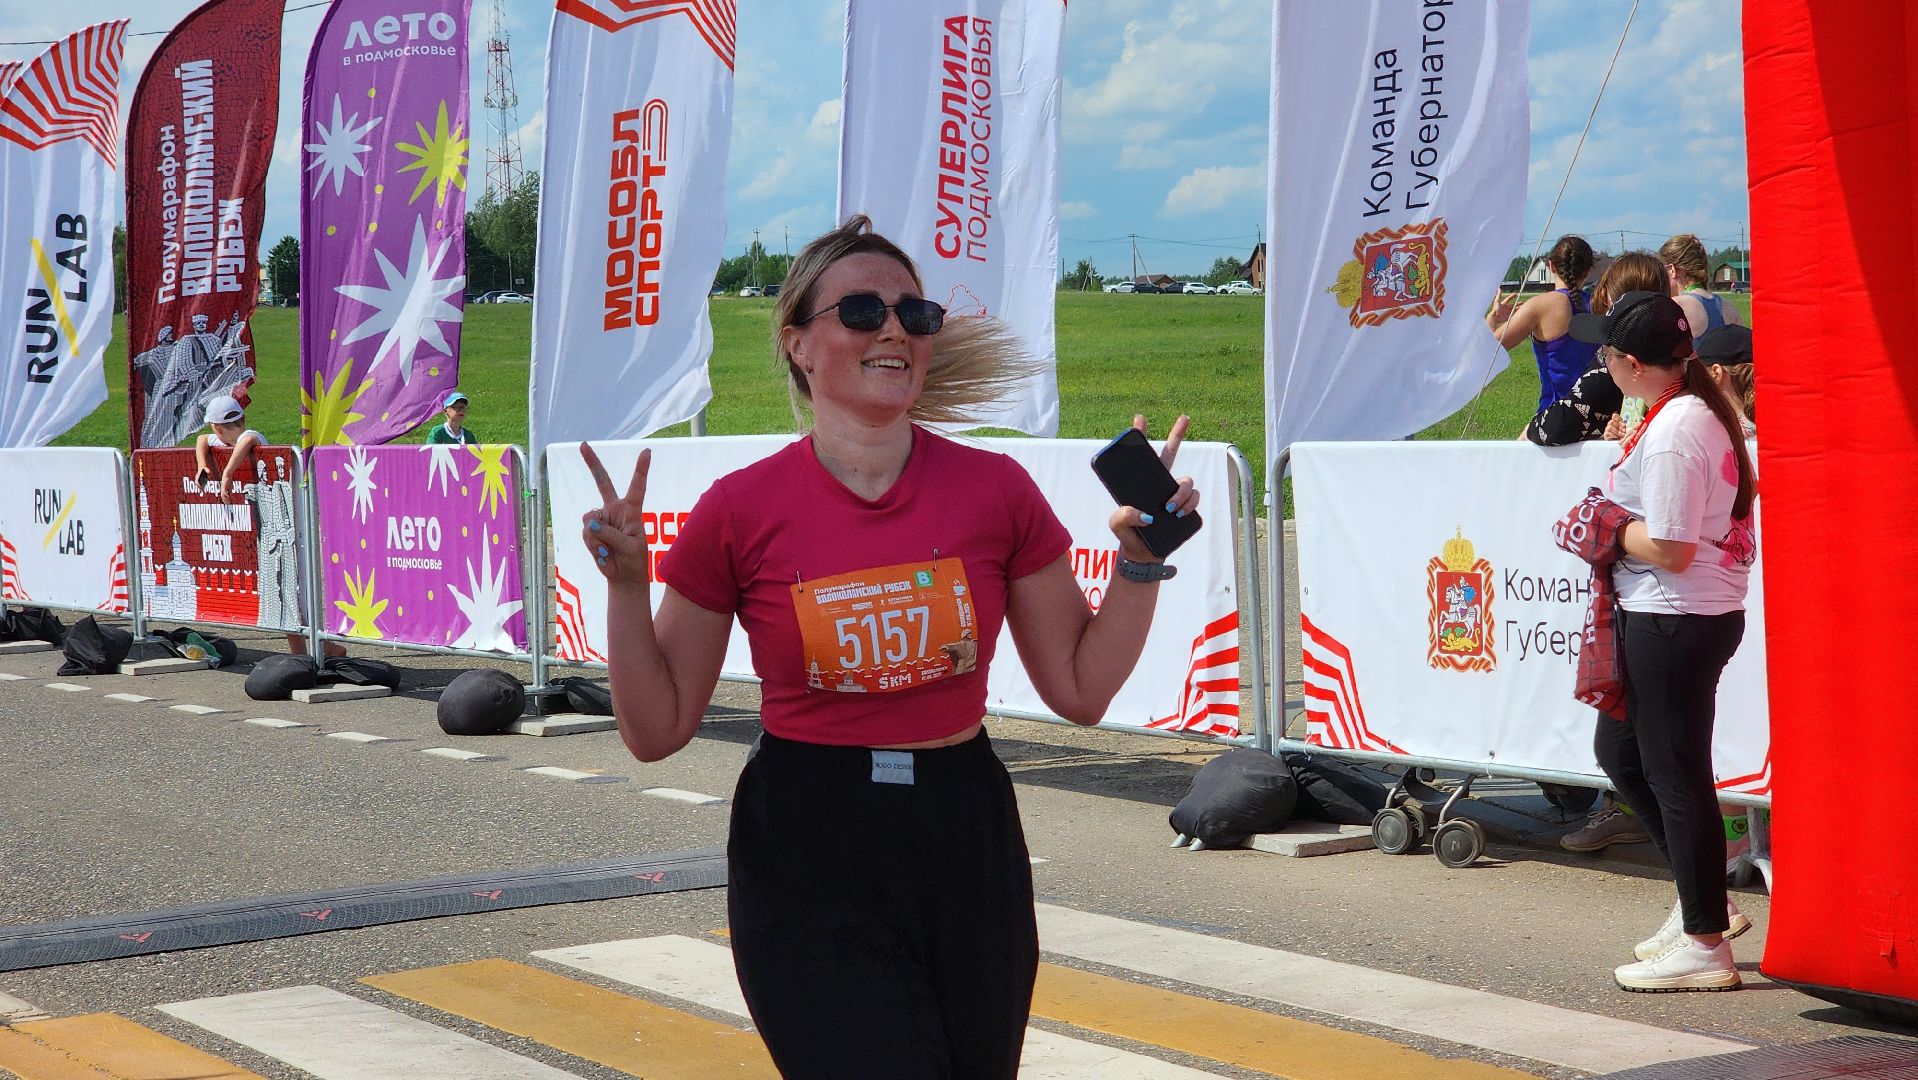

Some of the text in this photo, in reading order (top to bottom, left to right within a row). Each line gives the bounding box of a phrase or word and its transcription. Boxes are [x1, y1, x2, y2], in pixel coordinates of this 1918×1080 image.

[343, 45, 456, 66] в подмосковье
[174, 59, 214, 297] ВОЛОКОЛАМСКИЙ
[935, 15, 969, 260] СУПЕРЛИГА
[966, 16, 993, 263] ПОДМОСКОВЬЯ
[1363, 48, 1403, 218] Команда
[56, 213, 88, 303] LAB
[158, 125, 182, 305] Полумарафон
[216, 197, 246, 293] РУБЕЖ
[604, 108, 640, 332] МОСОБЛ
[635, 154, 667, 326] СПОРТ
[26, 288, 58, 384] RUN
[34, 488, 62, 525] RUN
[59, 519, 85, 556] LAB
[201, 533, 233, 562] РУБЕЖ
[392, 557, 443, 571] подмосковье
[1505, 567, 1590, 603] Коман
[835, 605, 929, 669] 5157
[1506, 620, 1581, 664] Губер
